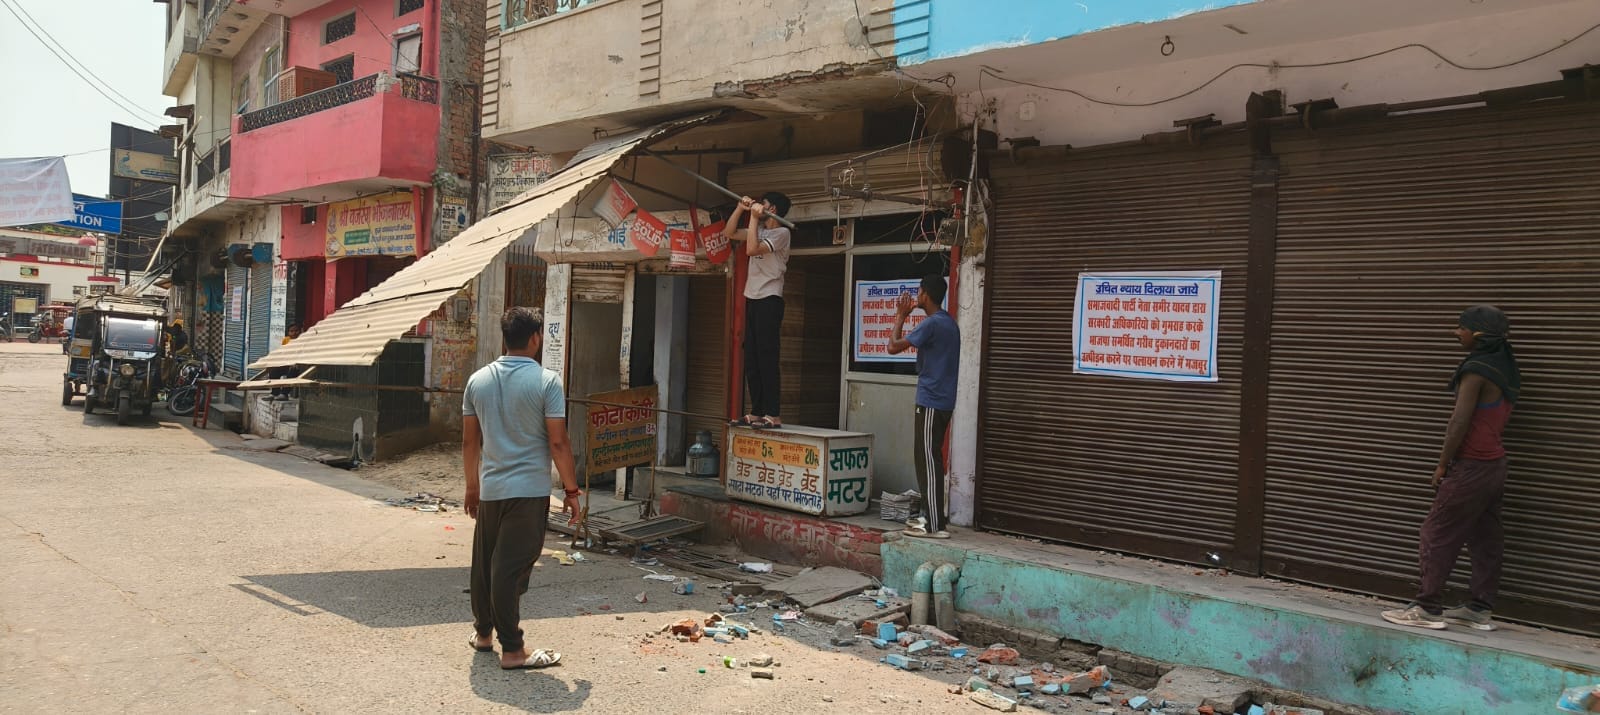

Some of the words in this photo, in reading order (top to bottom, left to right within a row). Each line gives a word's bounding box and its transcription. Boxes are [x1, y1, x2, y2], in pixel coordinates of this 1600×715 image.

[373, 200, 412, 222] भोजनालय
[634, 222, 662, 244] SOLID
[705, 232, 729, 252] SOLID
[867, 286, 882, 296] उचित
[1096, 282, 1118, 295] उचित
[1120, 284, 1142, 294] न्याय
[1144, 282, 1174, 295] दिलाया
[1178, 283, 1199, 296] जाये
[1088, 298, 1120, 312] समाजवादी
[1122, 298, 1136, 312] पार्टी
[1138, 298, 1150, 312] नेता
[1152, 299, 1170, 312] समीर
[1172, 302, 1190, 313] यादव
[548, 322, 560, 339] दूध
[1088, 316, 1110, 328] सरकारी
[1150, 317, 1160, 331] को
[1162, 320, 1183, 334] गुमराह
[1186, 319, 1204, 333] करके
[1089, 335, 1110, 346] भाजपा
[1112, 334, 1134, 348] समर्थित
[1136, 335, 1153, 348] गरीब
[1155, 336, 1188, 352] दुकानदारों
[1190, 340, 1200, 351] का
[1106, 352, 1121, 365] करने
[1123, 355, 1131, 366] पर
[1133, 355, 1157, 367] पलायन
[1160, 355, 1175, 368] करने
[1177, 355, 1185, 368] में
[1186, 358, 1208, 374] मजबूर
[762, 442, 767, 458] 5
[804, 448, 815, 465] 20
[829, 446, 868, 471] सफल
[781, 488, 792, 503] पर
[828, 477, 866, 504] मटर
